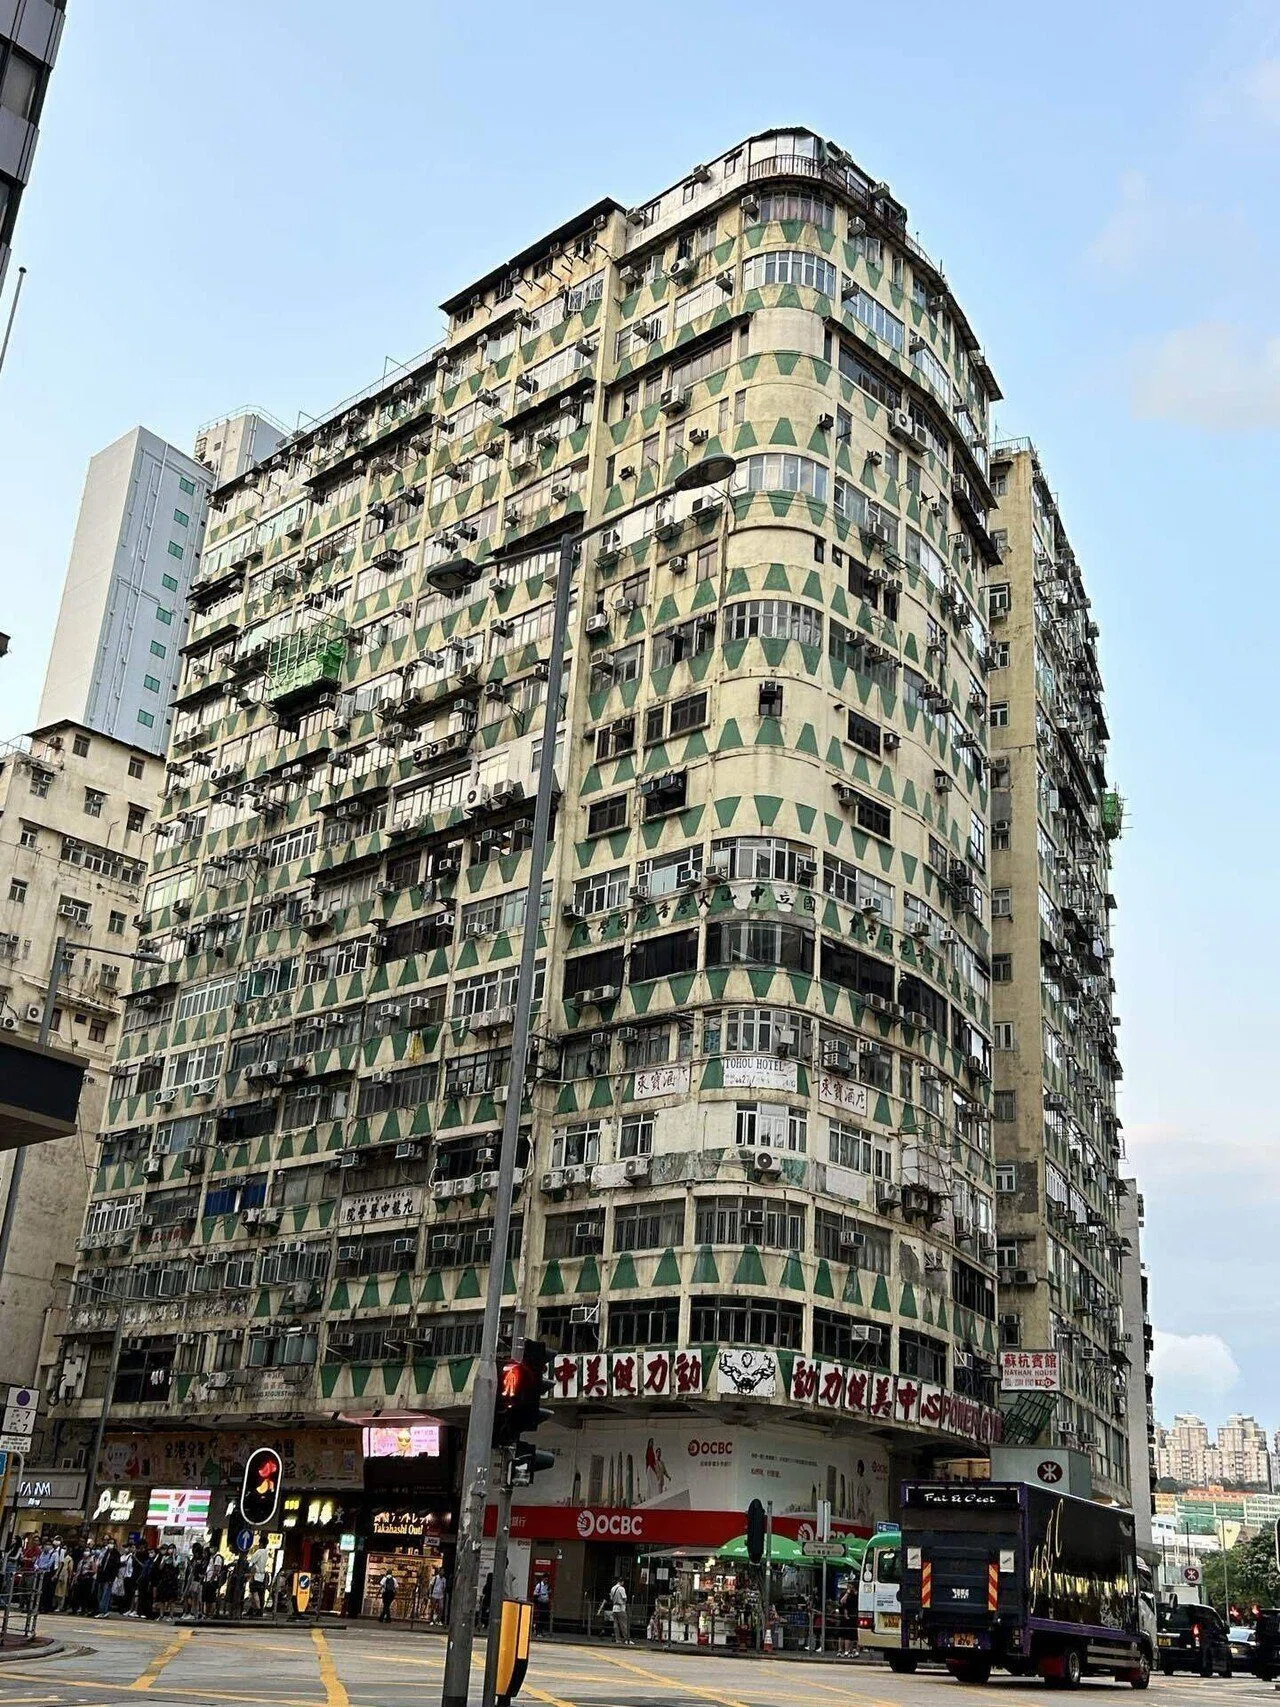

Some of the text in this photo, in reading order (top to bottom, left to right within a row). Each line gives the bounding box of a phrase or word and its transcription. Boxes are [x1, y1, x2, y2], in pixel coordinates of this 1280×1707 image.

[726, 1057, 784, 1072] TOHOU HOTEL
[1004, 1353, 1057, 1369] 蘇杭賓館
[701, 1441, 733, 1455] OCBC
[596, 1515, 643, 1536] OCBC
